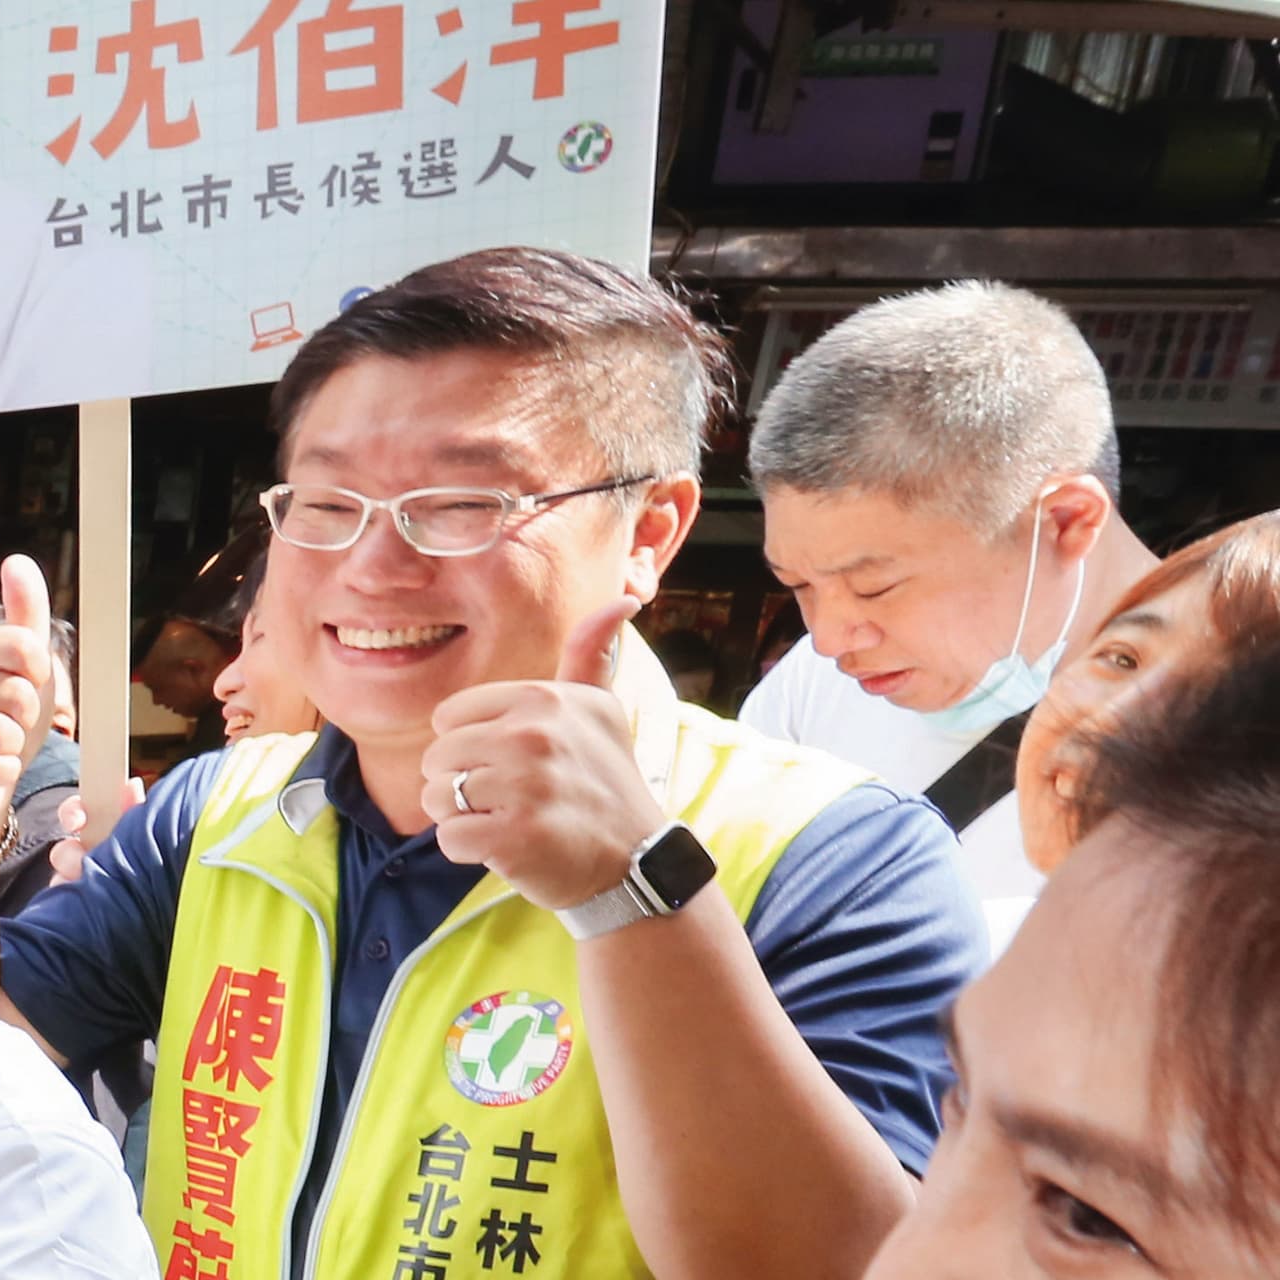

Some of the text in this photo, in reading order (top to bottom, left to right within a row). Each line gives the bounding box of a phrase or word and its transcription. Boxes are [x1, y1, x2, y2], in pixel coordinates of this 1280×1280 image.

[44, 0, 620, 166] 沈伯洋
[45, 134, 536, 249] 台北市長候選人
